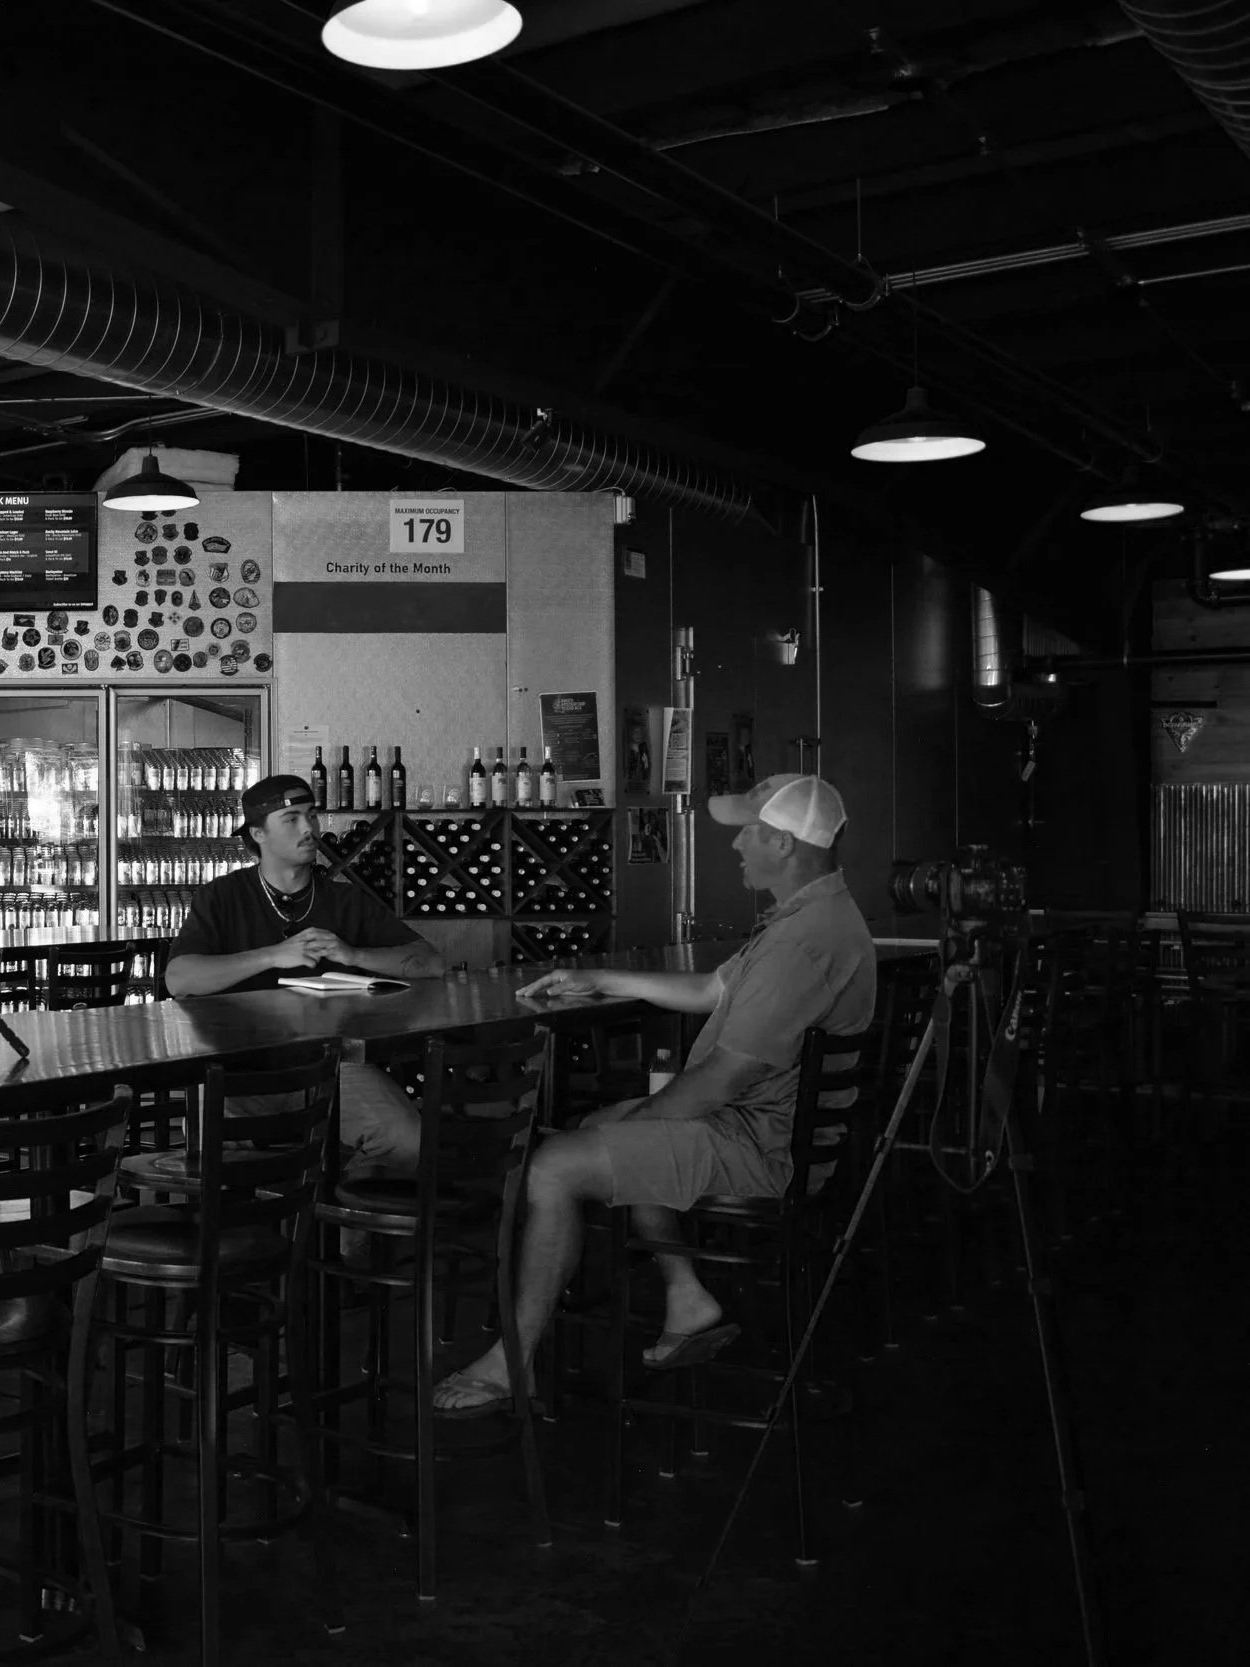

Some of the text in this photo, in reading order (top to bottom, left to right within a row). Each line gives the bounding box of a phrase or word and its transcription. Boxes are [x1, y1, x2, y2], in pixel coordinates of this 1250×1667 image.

[5, 496, 29, 505] MENU
[402, 518, 452, 543] 179
[326, 562, 451, 576] Charity of the Month
